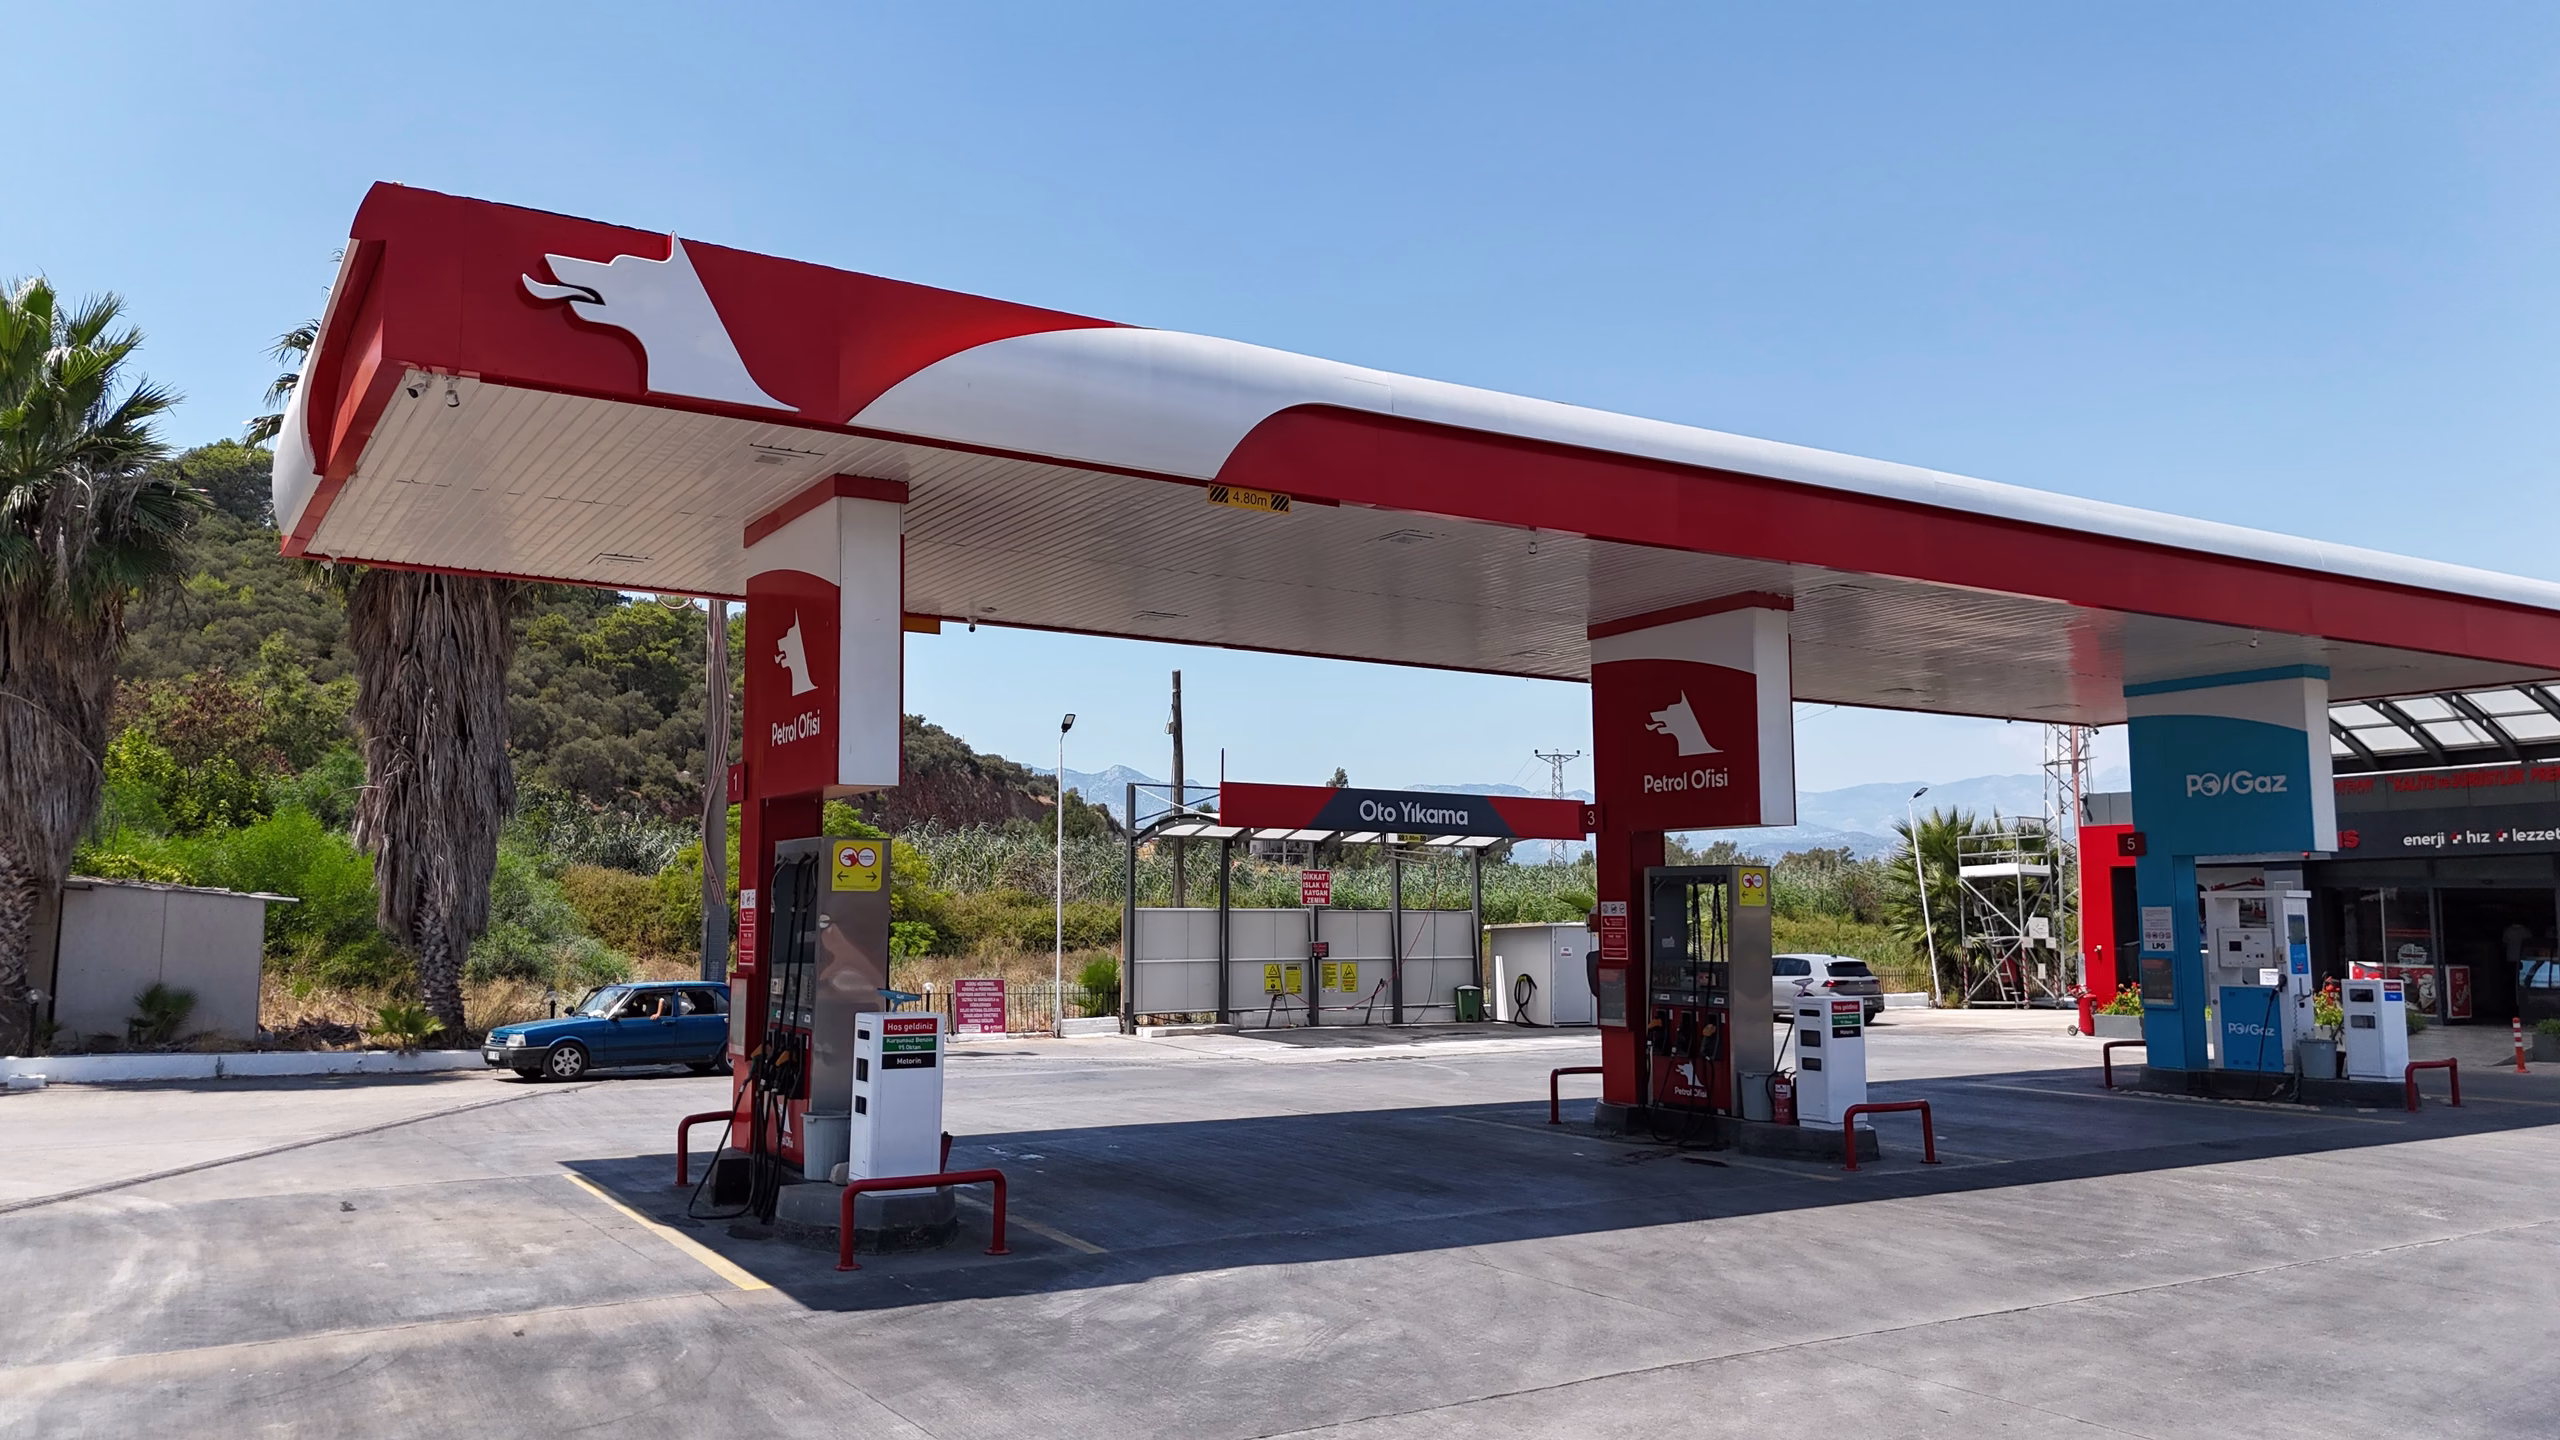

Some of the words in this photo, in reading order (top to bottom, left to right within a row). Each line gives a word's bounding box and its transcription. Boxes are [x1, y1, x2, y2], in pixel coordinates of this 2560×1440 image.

[1232, 491, 1267, 507] 4.80m
[771, 717, 797, 747] Petrol
[798, 709, 820, 739] Ofisi
[733, 772, 738, 791] 1
[1644, 772, 1688, 793] Petrol
[1691, 767, 1728, 789] Ofisi
[1360, 800, 1396, 821] Oto
[1399, 802, 1468, 825] Yıkama
[1587, 811, 1595, 825] 3
[2127, 837, 2135, 850] 5
[2403, 832, 2445, 848] enerji
[2466, 830, 2490, 843] hız
[2512, 828, 2560, 841] lezzet
[904, 1022, 933, 1032] geldiniz
